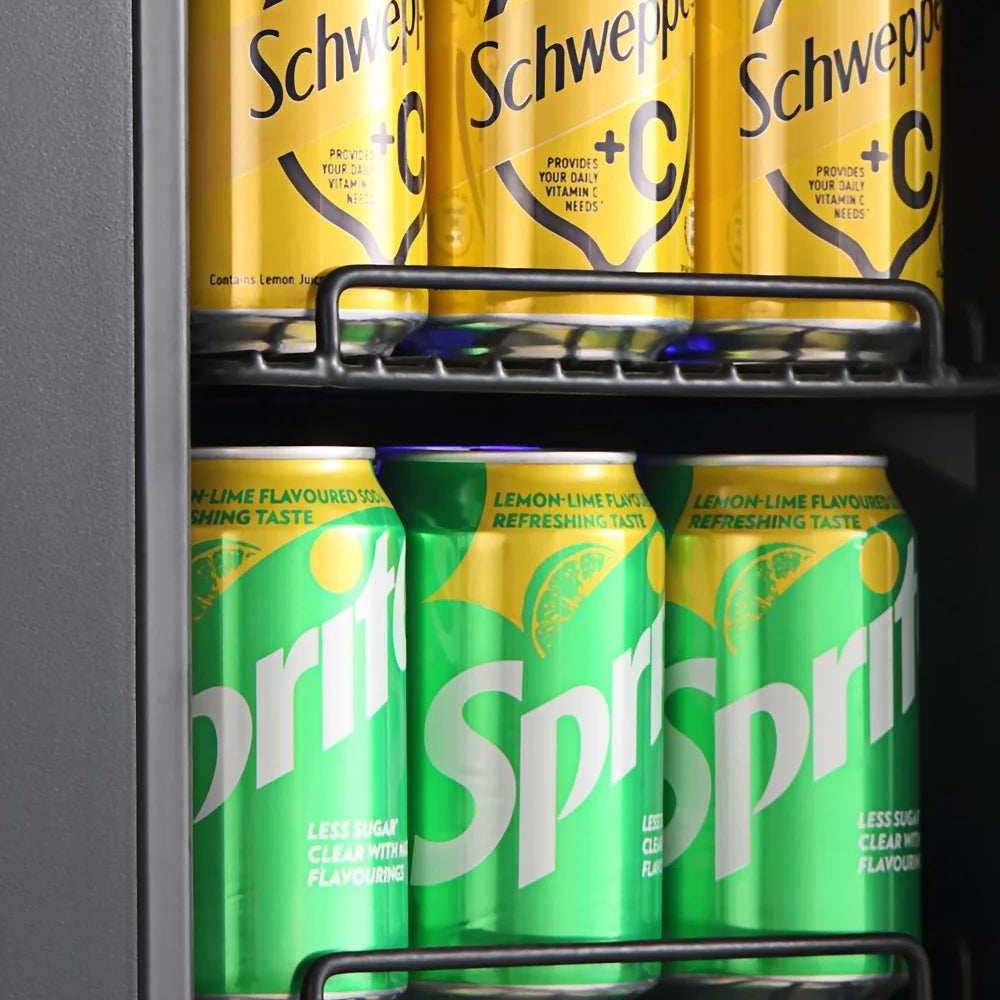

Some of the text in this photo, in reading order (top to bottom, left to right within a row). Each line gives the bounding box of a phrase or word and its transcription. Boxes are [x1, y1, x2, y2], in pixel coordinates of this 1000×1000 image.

[322, 163, 347, 175] YOUR
[547, 157, 598, 170] PROVIDES
[816, 165, 865, 178] PROVIDES
[539, 171, 598, 184] YOUR DAILY
[545, 185, 598, 198] VITAMIN C
[808, 180, 865, 192] YOUR DAILY
[815, 194, 865, 205] VITAMIN C
[209, 273, 324, 286] Contains Lemon Juic
[259, 488, 358, 505] FLAVOURED
[493, 492, 603, 509] LEMON-LIME
[693, 493, 808, 510] LEMON-LIME
[255, 509, 314, 526] TASTE
[492, 513, 647, 529] REFRESHING TASTE
[687, 514, 861, 530] REFRESHING TASTE
[857, 811, 892, 829] LESS
[306, 821, 350, 840] LESS
[857, 832, 902, 851] CLEAR
[307, 844, 365, 864] CLEAR
[368, 841, 399, 860] WITH
[307, 864, 405, 887] FLAVOURINGS
